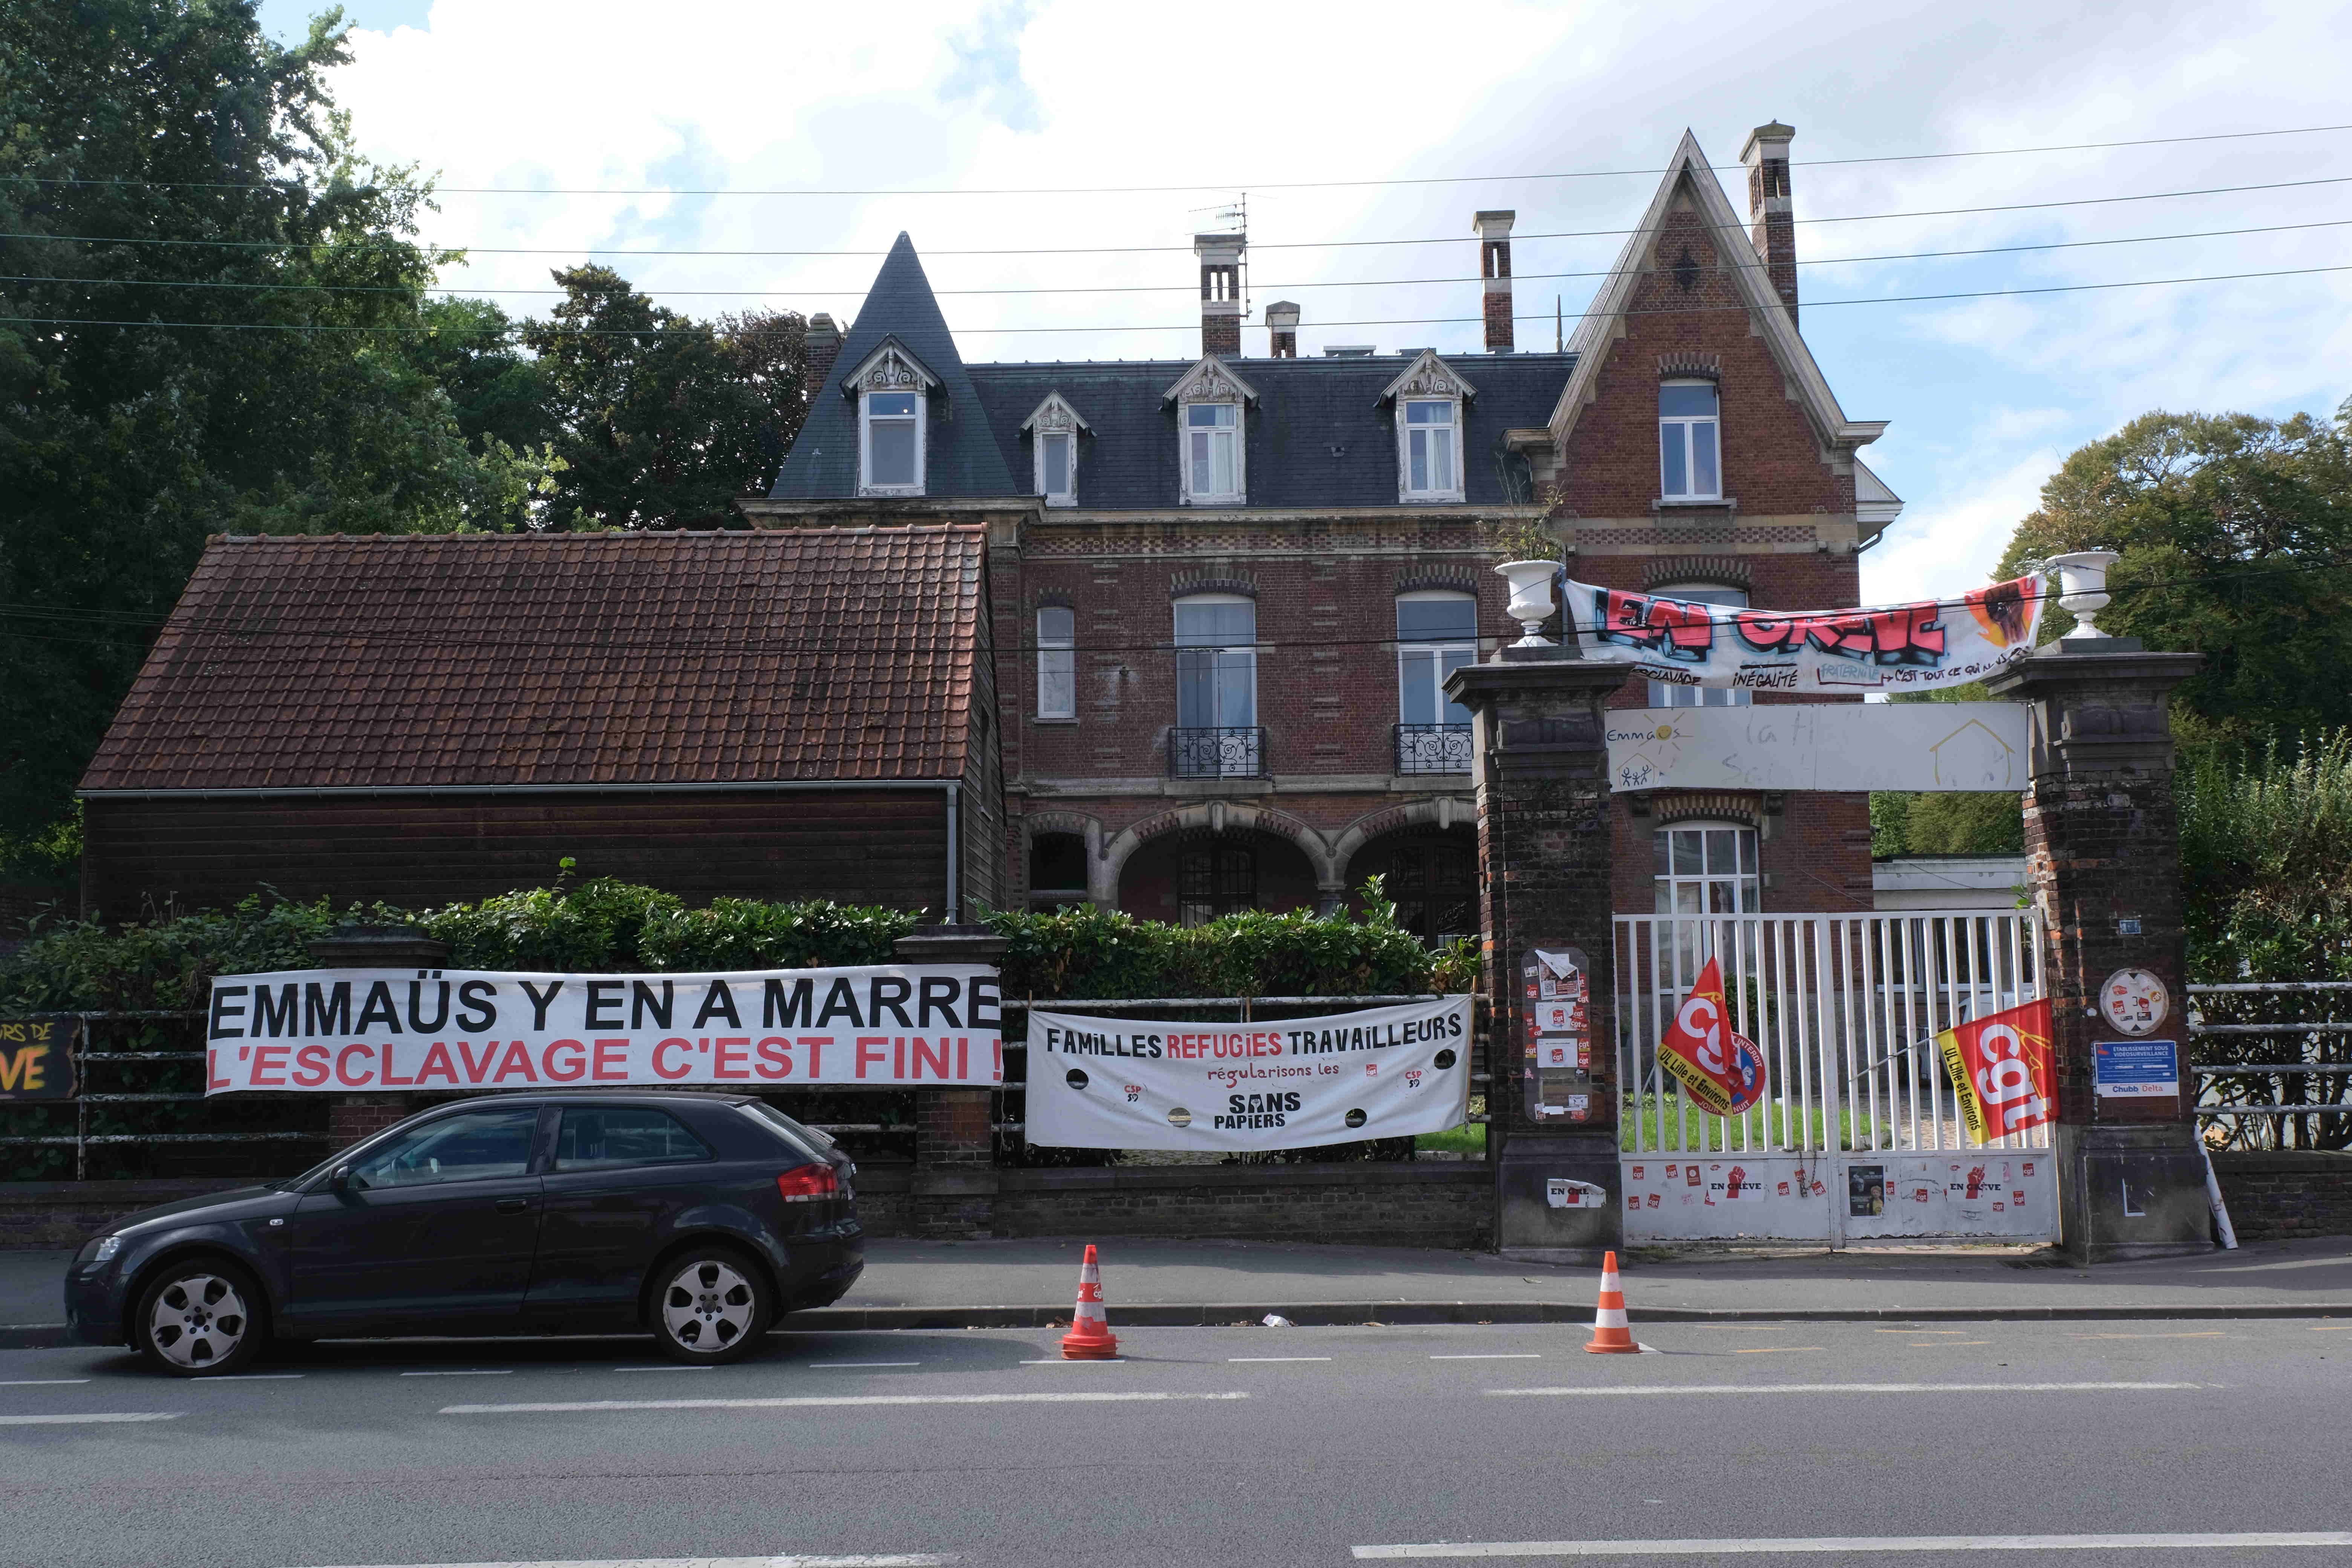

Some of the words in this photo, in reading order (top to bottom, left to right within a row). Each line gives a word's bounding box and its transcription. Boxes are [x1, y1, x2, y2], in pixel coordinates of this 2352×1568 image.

[1920, 669, 1945, 680] TOUT
[1948, 667, 1961, 676] CE
[210, 970, 497, 1040] EMMAÜS
[518, 980, 564, 1031] Y
[585, 980, 674, 1030] EN
[692, 980, 742, 1029] A
[763, 976, 1001, 1030] MARRE
[30, 1023, 54, 1040] DE
[1678, 998, 1726, 1075] cg
[1737, 1038, 1762, 1067] INTERDIT
[1944, 1047, 1958, 1061] UL
[208, 1038, 630, 1091] L'ESCLAVAGE
[651, 1037, 834, 1080] C'EST
[1949, 1061, 1964, 1081] Lille
[1207, 1062, 1312, 1089] régularisons
[1318, 1063, 1339, 1075] les
[1405, 1071, 1422, 1079] CSP
[1660, 1049, 1672, 1065] UL
[1670, 1058, 1688, 1078] Lille
[1687, 1074, 1698, 1086] et
[1696, 1078, 1730, 1110] Environs
[1977, 1023, 2052, 1130] cgt
[1957, 1083, 1968, 1092] et
[1229, 1092, 1301, 1113] SANS
[1733, 1099, 1750, 1113] NUIT
[1961, 1092, 1980, 1130] Environs
[1727, 1181, 1761, 1190] GRÈVE
